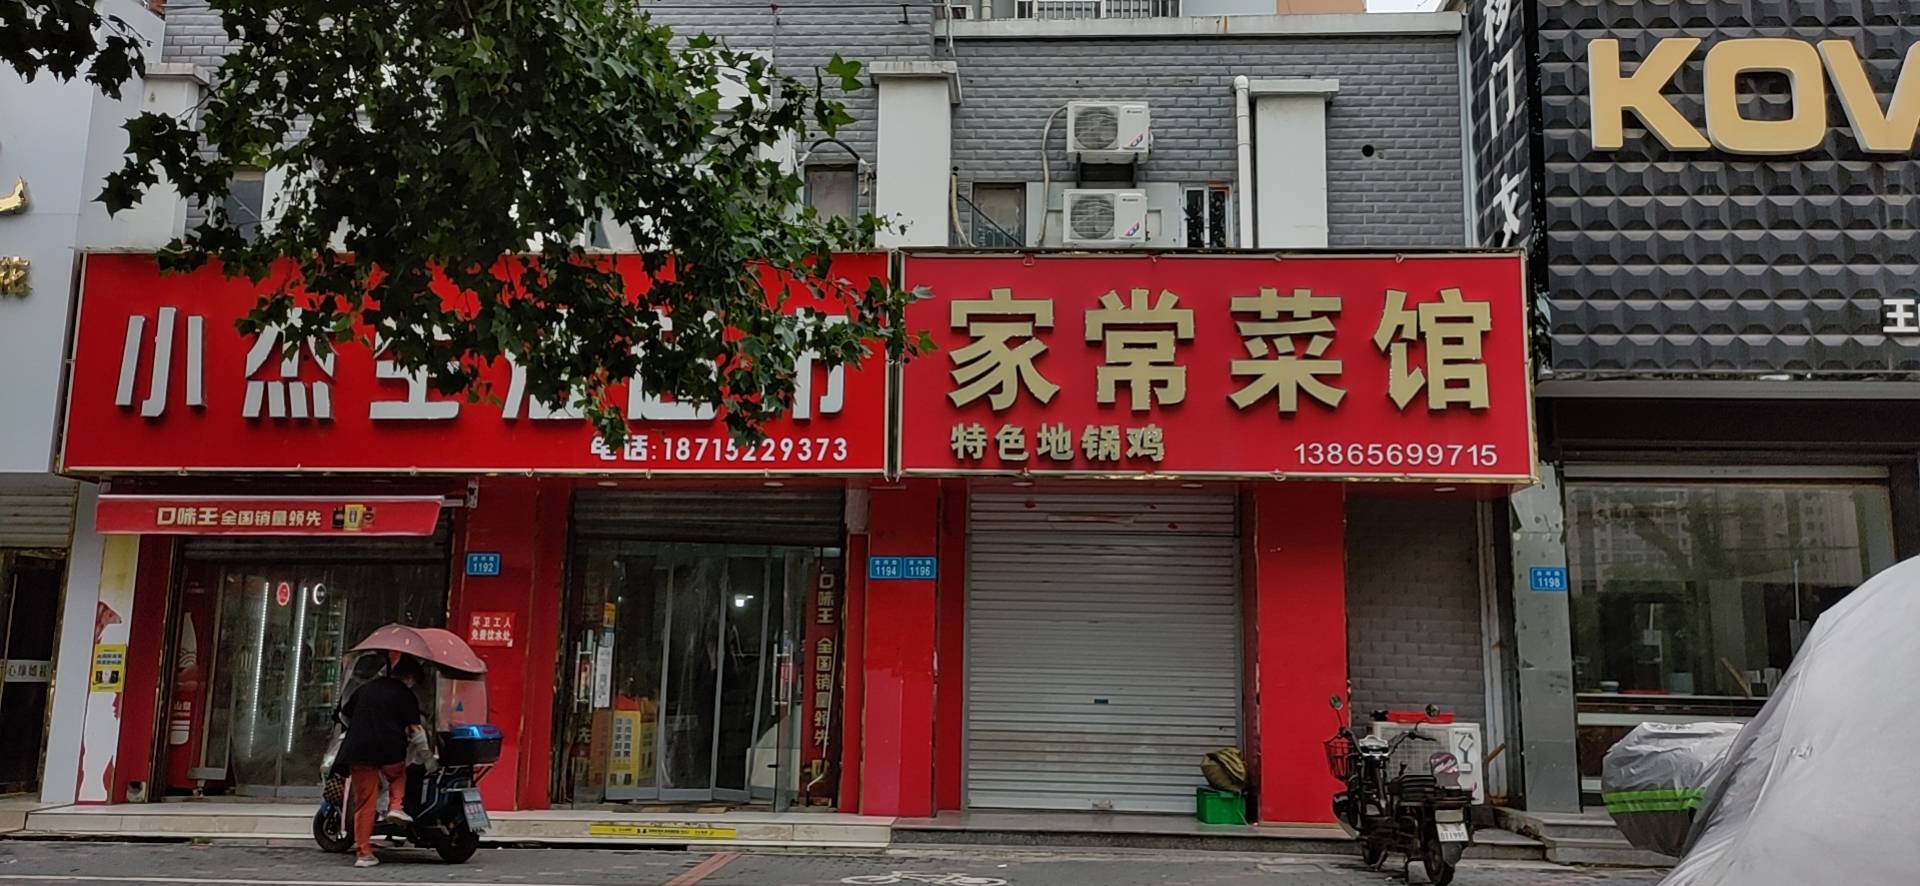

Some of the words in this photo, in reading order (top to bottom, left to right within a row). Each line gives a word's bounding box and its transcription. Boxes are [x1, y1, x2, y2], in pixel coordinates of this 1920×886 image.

[946, 287, 1493, 413] 家常菜馆
[950, 422, 1166, 462] 特色地锅鸡
[1293, 443, 1499, 467] 13865699715
[157, 506, 218, 526] 口味王
[220, 509, 322, 527] 全国销量领先
[473, 562, 494, 572] 1192
[875, 566, 897, 576] 1194
[910, 566, 931, 576] 1196
[1538, 577, 1560, 588] 1198
[816, 573, 835, 624] 口味王
[471, 616, 512, 628] 环卫工人
[470, 628, 512, 641] 免费饮水处
